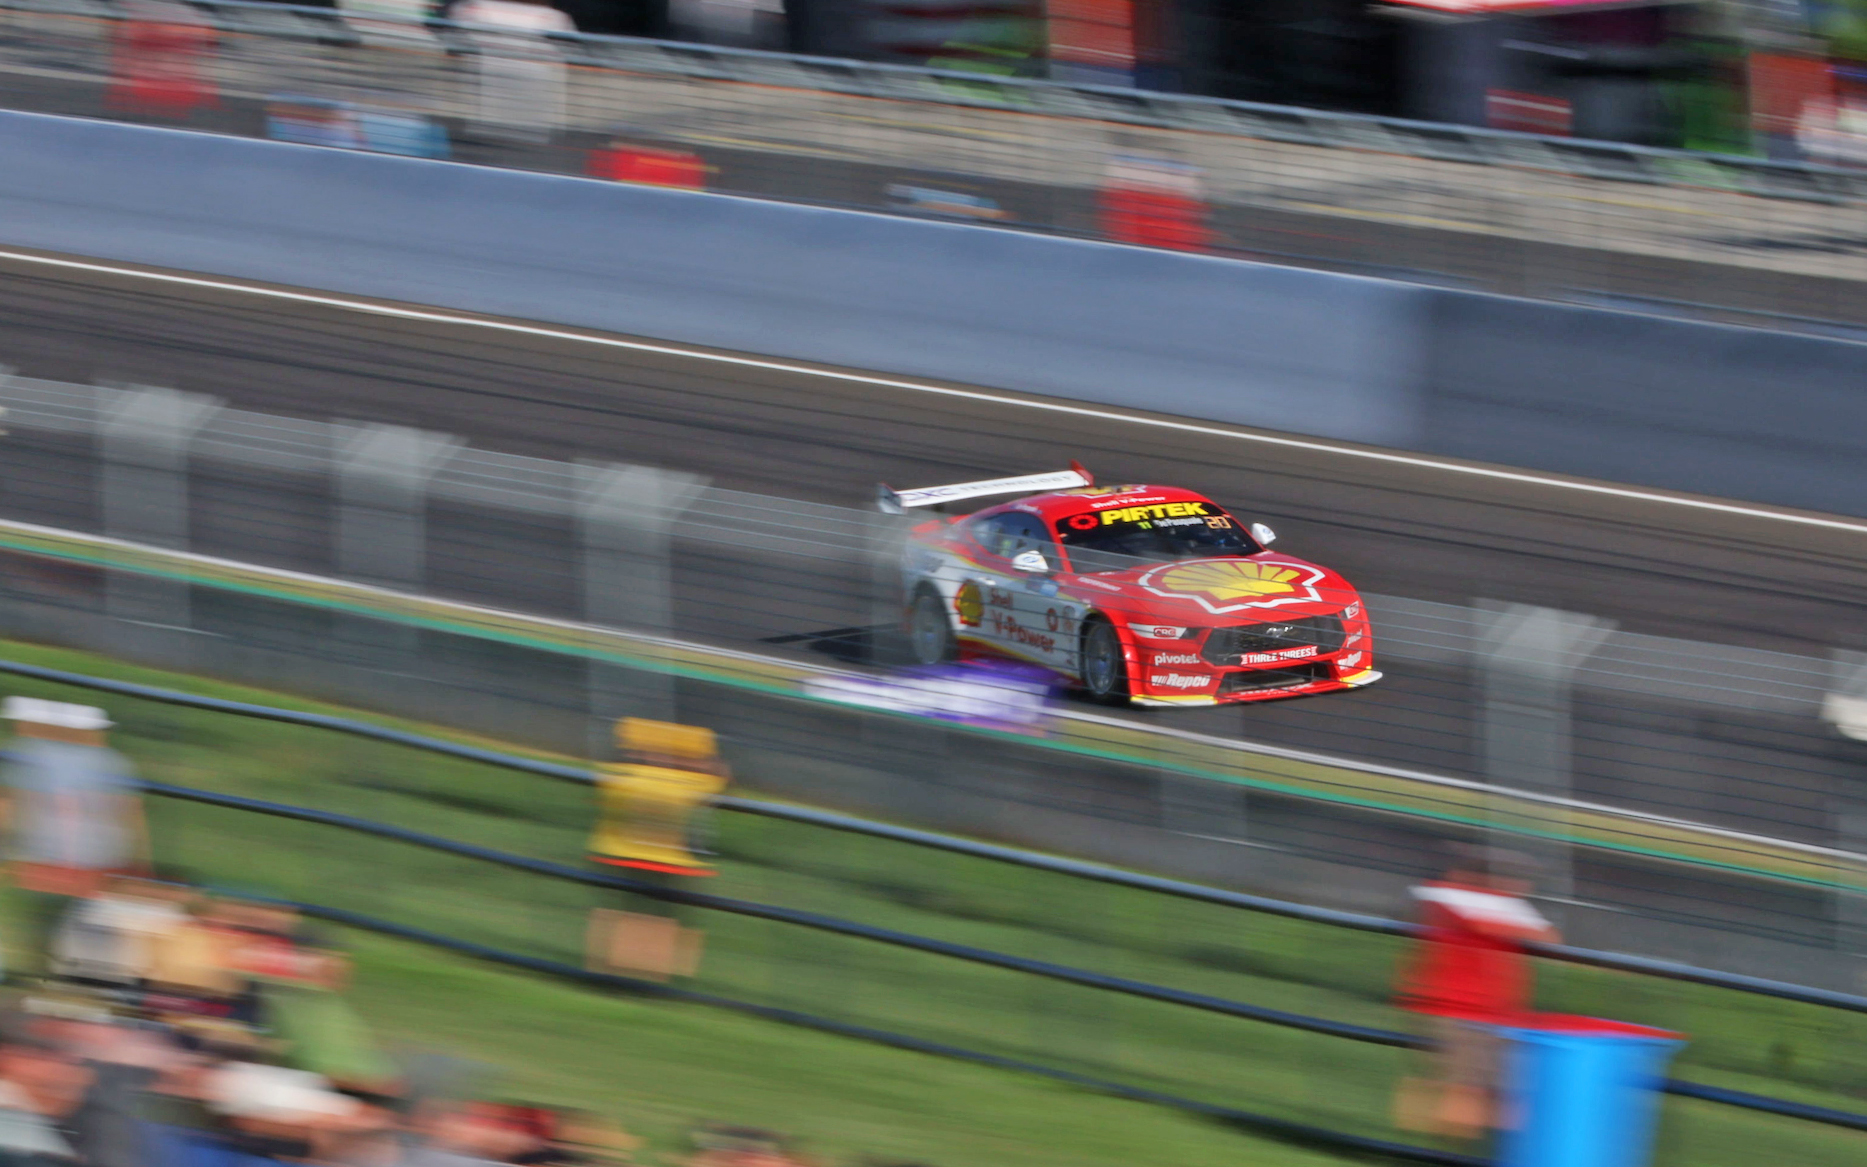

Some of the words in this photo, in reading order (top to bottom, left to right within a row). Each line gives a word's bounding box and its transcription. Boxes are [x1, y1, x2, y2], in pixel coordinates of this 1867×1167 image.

[1101, 502, 1209, 526] PIRTEK
[1248, 653, 1278, 664] THREE
[1279, 648, 1312, 660] THREES
[1166, 673, 1212, 690] Repco
